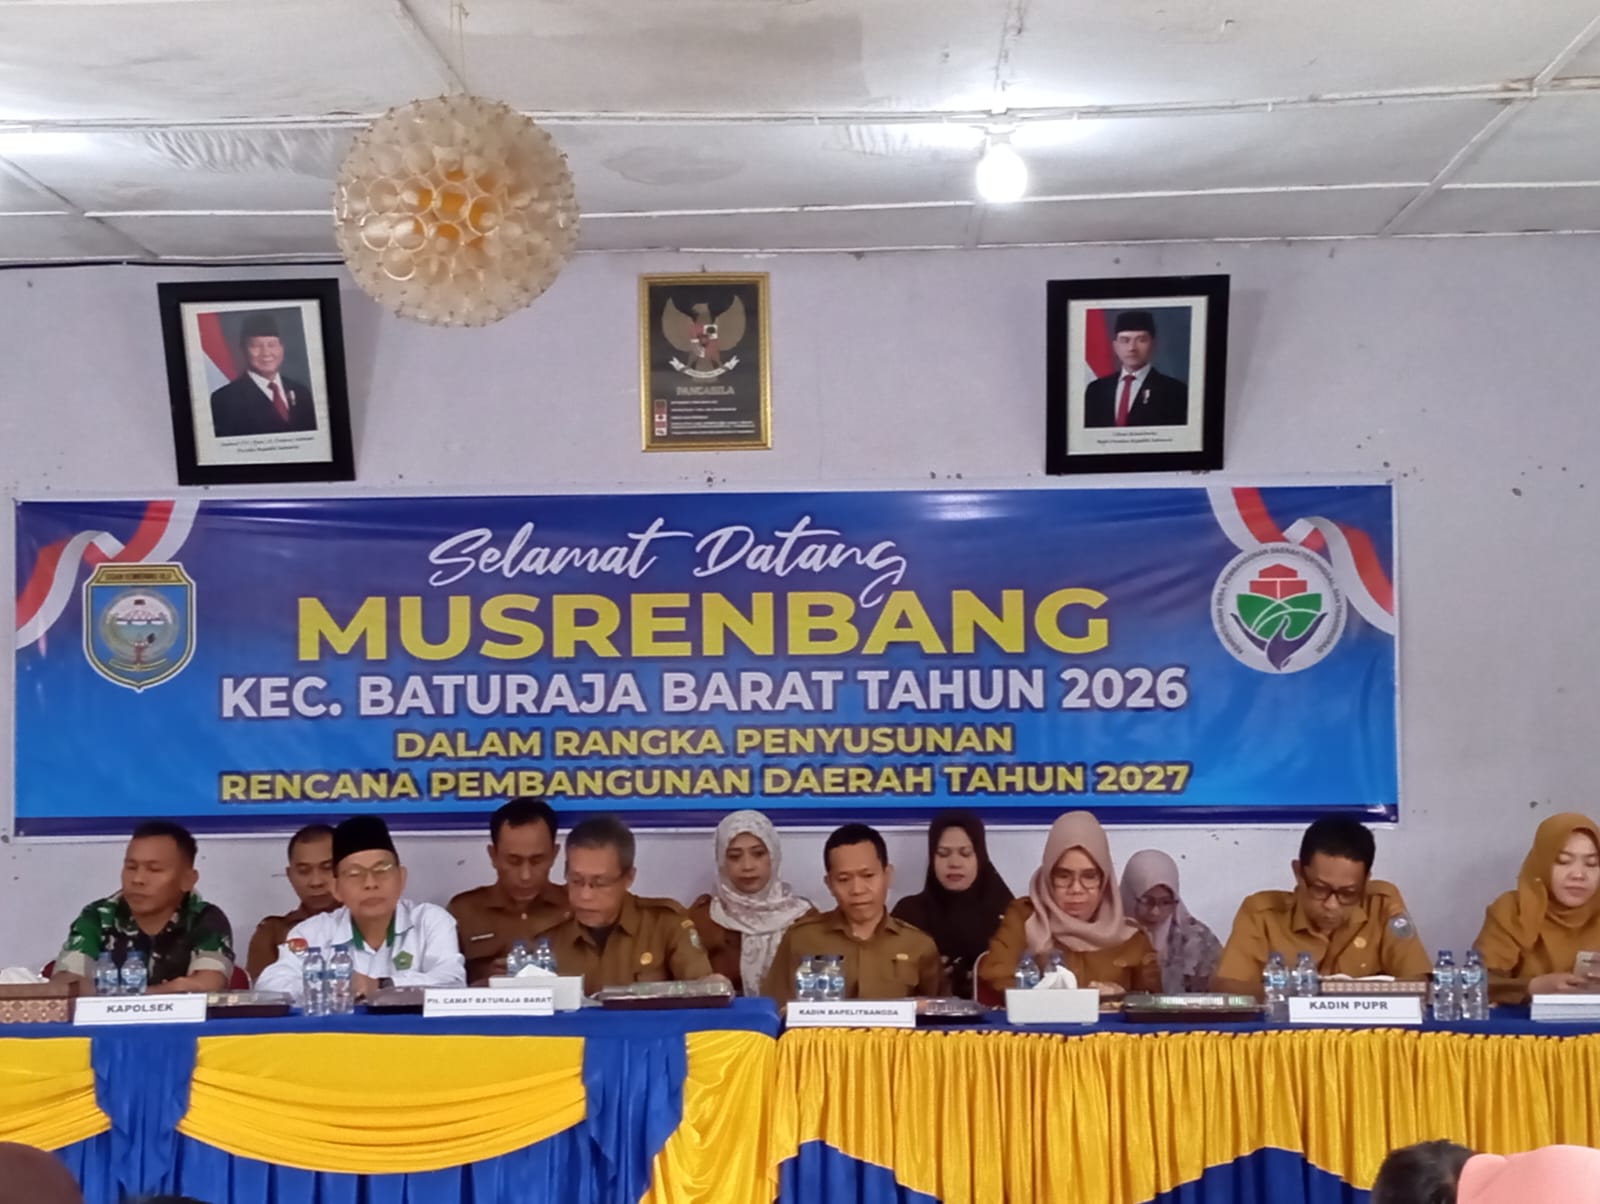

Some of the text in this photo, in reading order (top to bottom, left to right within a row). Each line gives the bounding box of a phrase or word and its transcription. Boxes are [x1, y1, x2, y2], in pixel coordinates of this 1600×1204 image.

[429, 515, 907, 608] Selamat Datang
[299, 587, 1109, 660] MUSRENBANG
[222, 667, 1188, 718] KEC. BATURAJA BARAT TAHUN 2026
[398, 727, 1013, 757] DALAM RANGKA PENYUSUNAN
[222, 765, 1192, 800] RENCANA PEMBANGUNAN DAERAH TAHUN 2027
[106, 1003, 174, 1013] KAPOLSEK
[1308, 1001, 1389, 1011] KADIN PUPR
